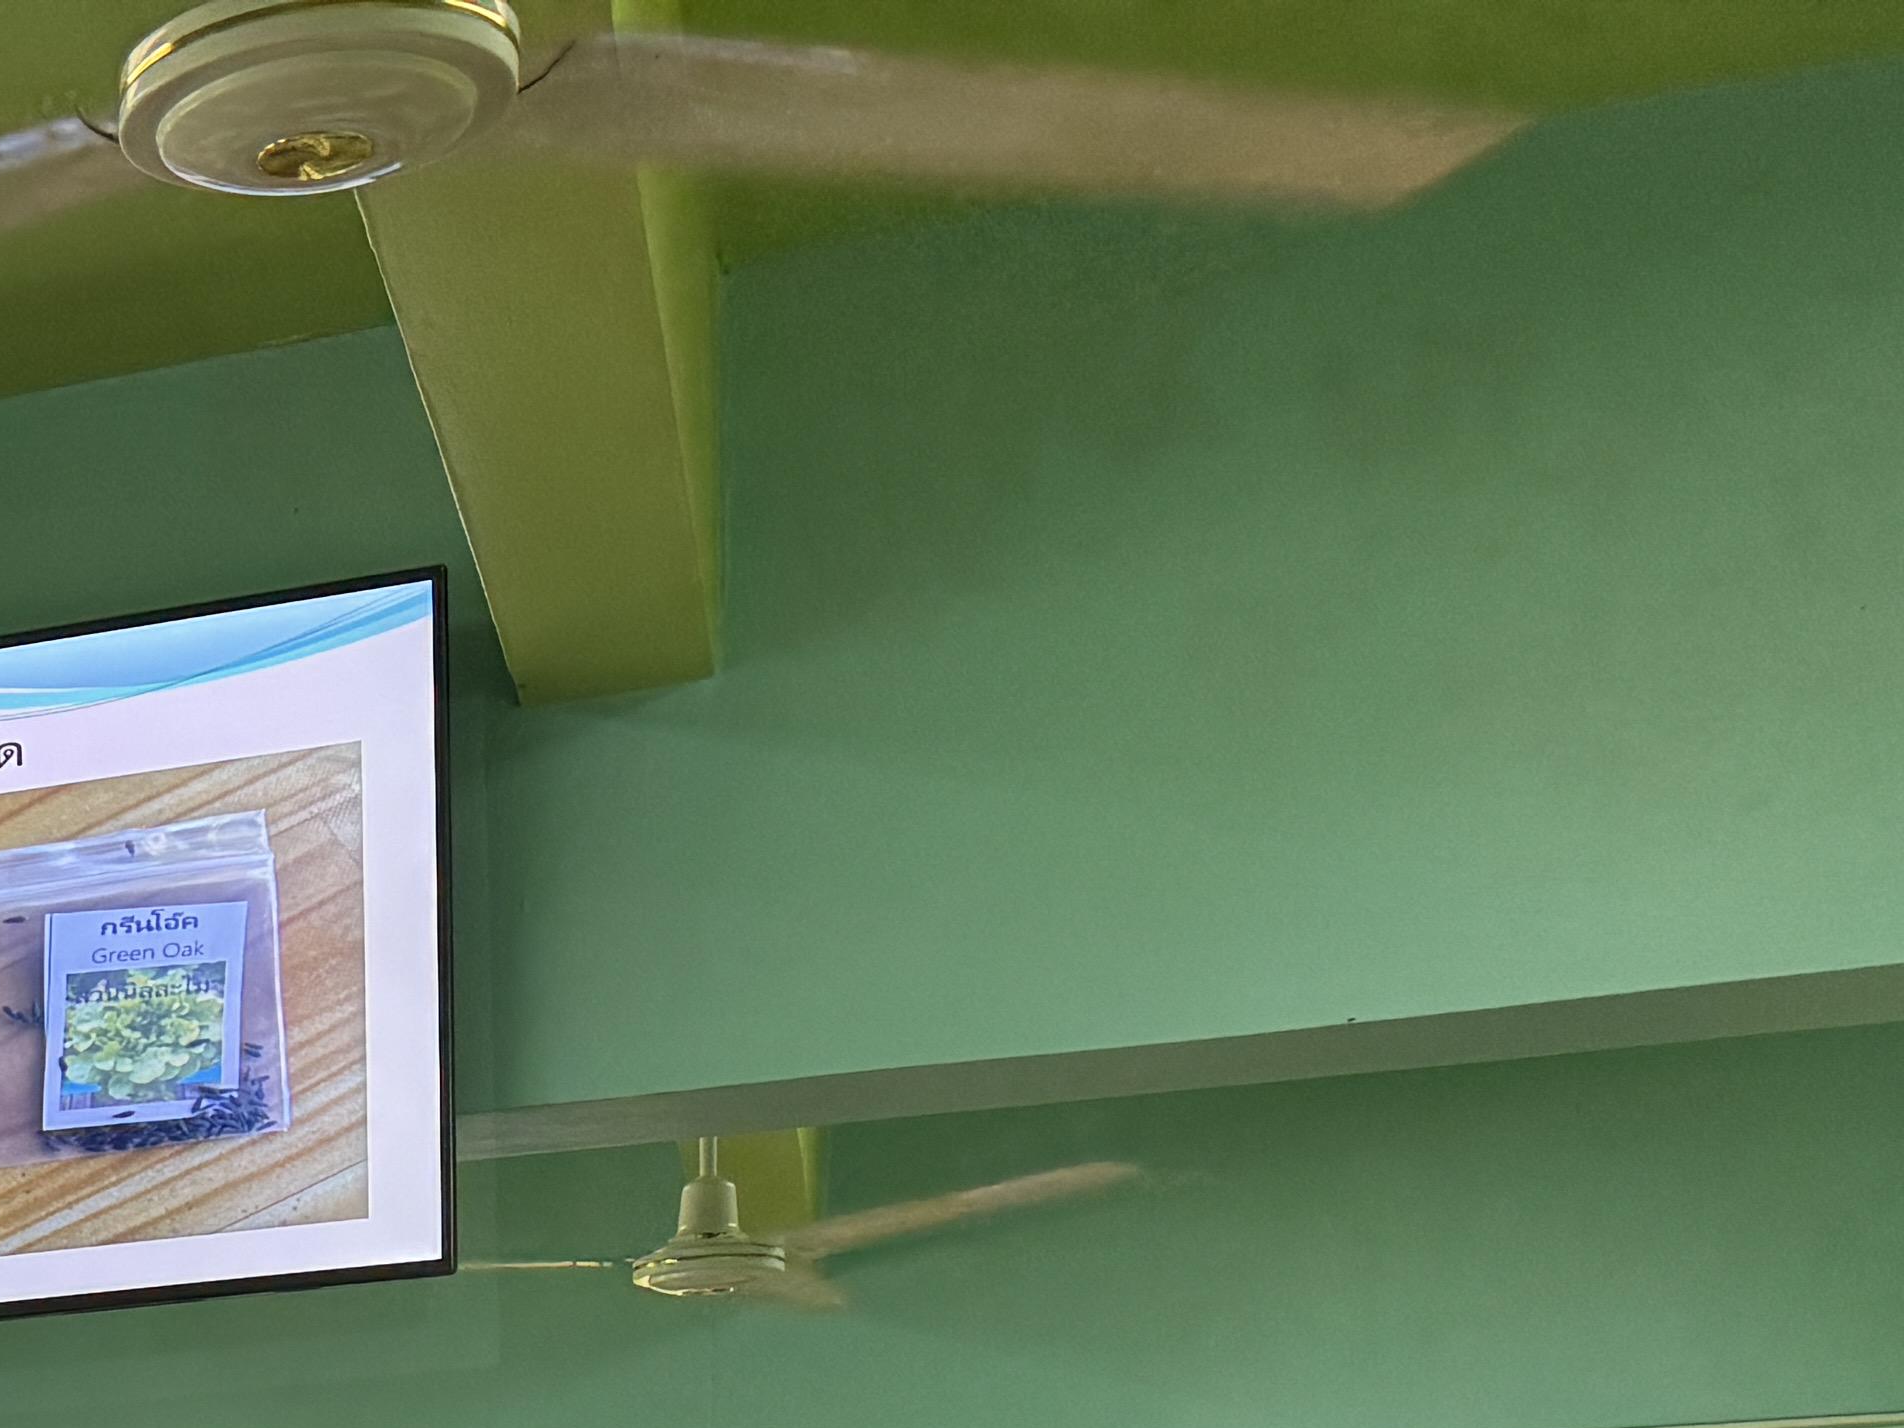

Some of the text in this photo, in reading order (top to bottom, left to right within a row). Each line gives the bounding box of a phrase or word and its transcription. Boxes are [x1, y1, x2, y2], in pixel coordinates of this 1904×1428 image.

[100, 908, 199, 936] กรีนโอ๊ค
[91, 940, 205, 964] Green Oak
